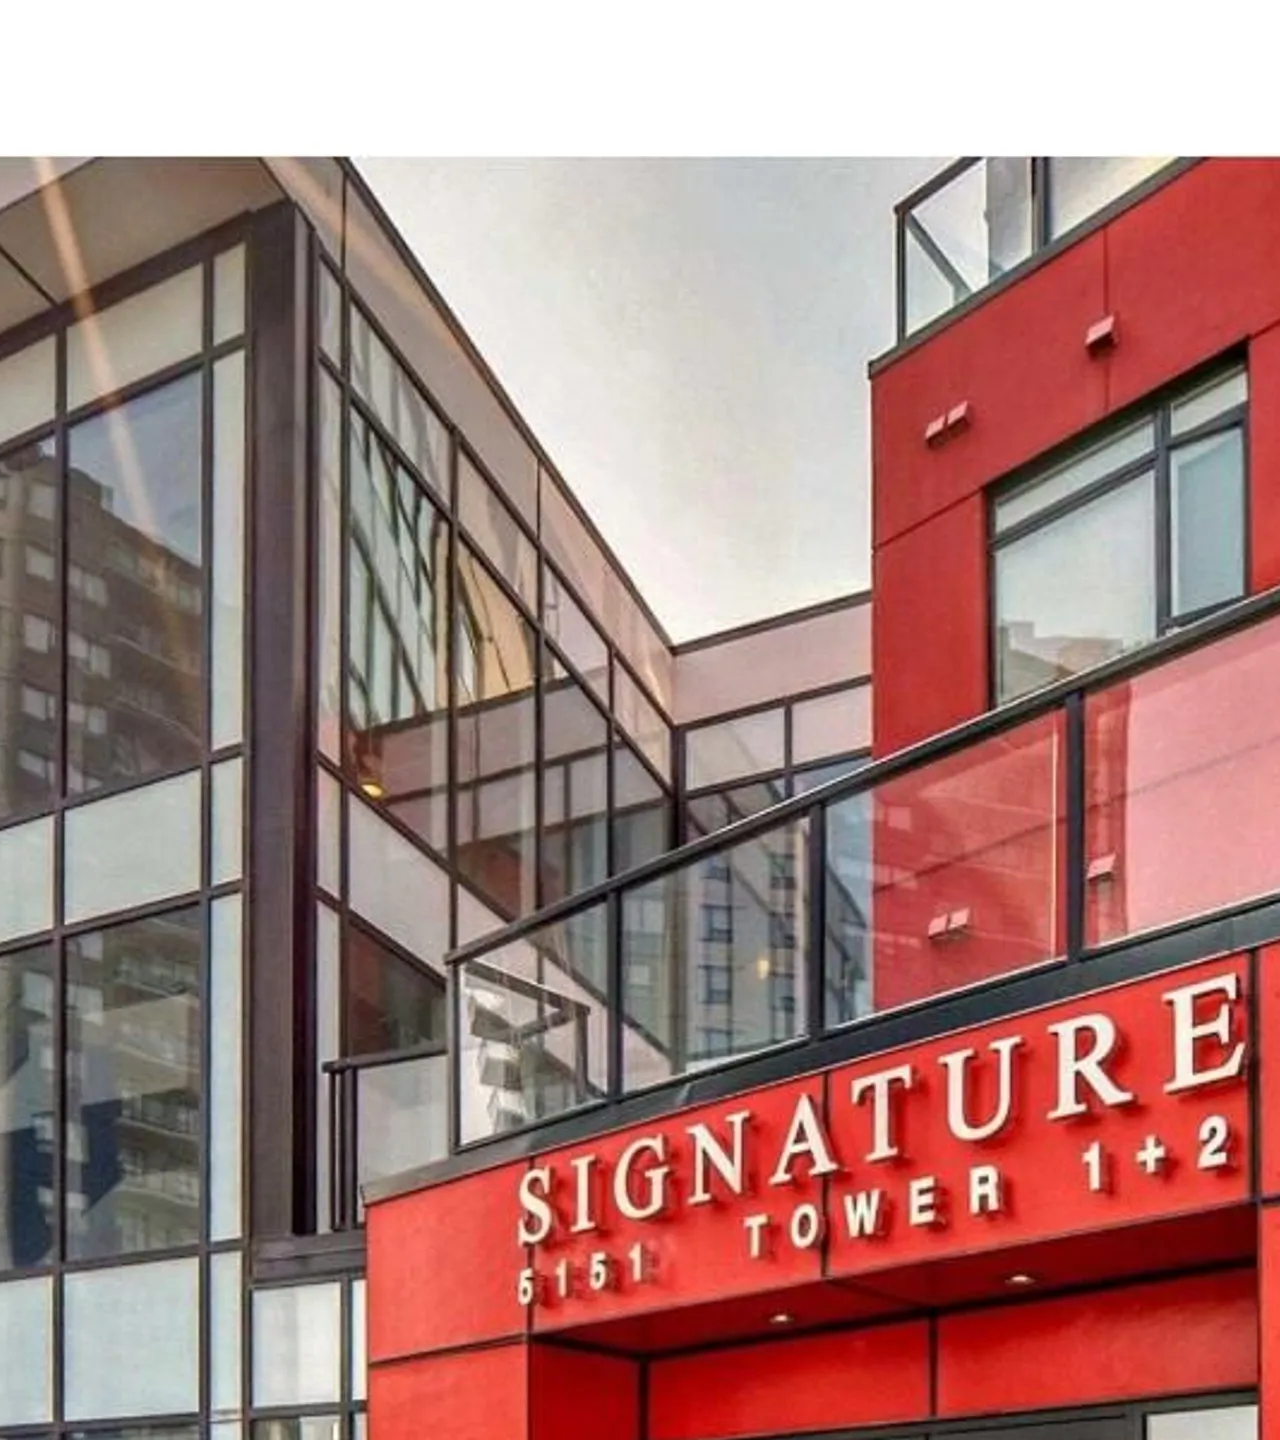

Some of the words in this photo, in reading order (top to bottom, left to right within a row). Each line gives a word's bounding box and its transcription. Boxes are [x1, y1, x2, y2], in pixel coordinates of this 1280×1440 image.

[516, 1243, 649, 1305] 5151
[745, 1166, 1002, 1259] TOWER
[1083, 1115, 1230, 1191] 1+2
[517, 972, 1246, 1246] SIGNATURE
